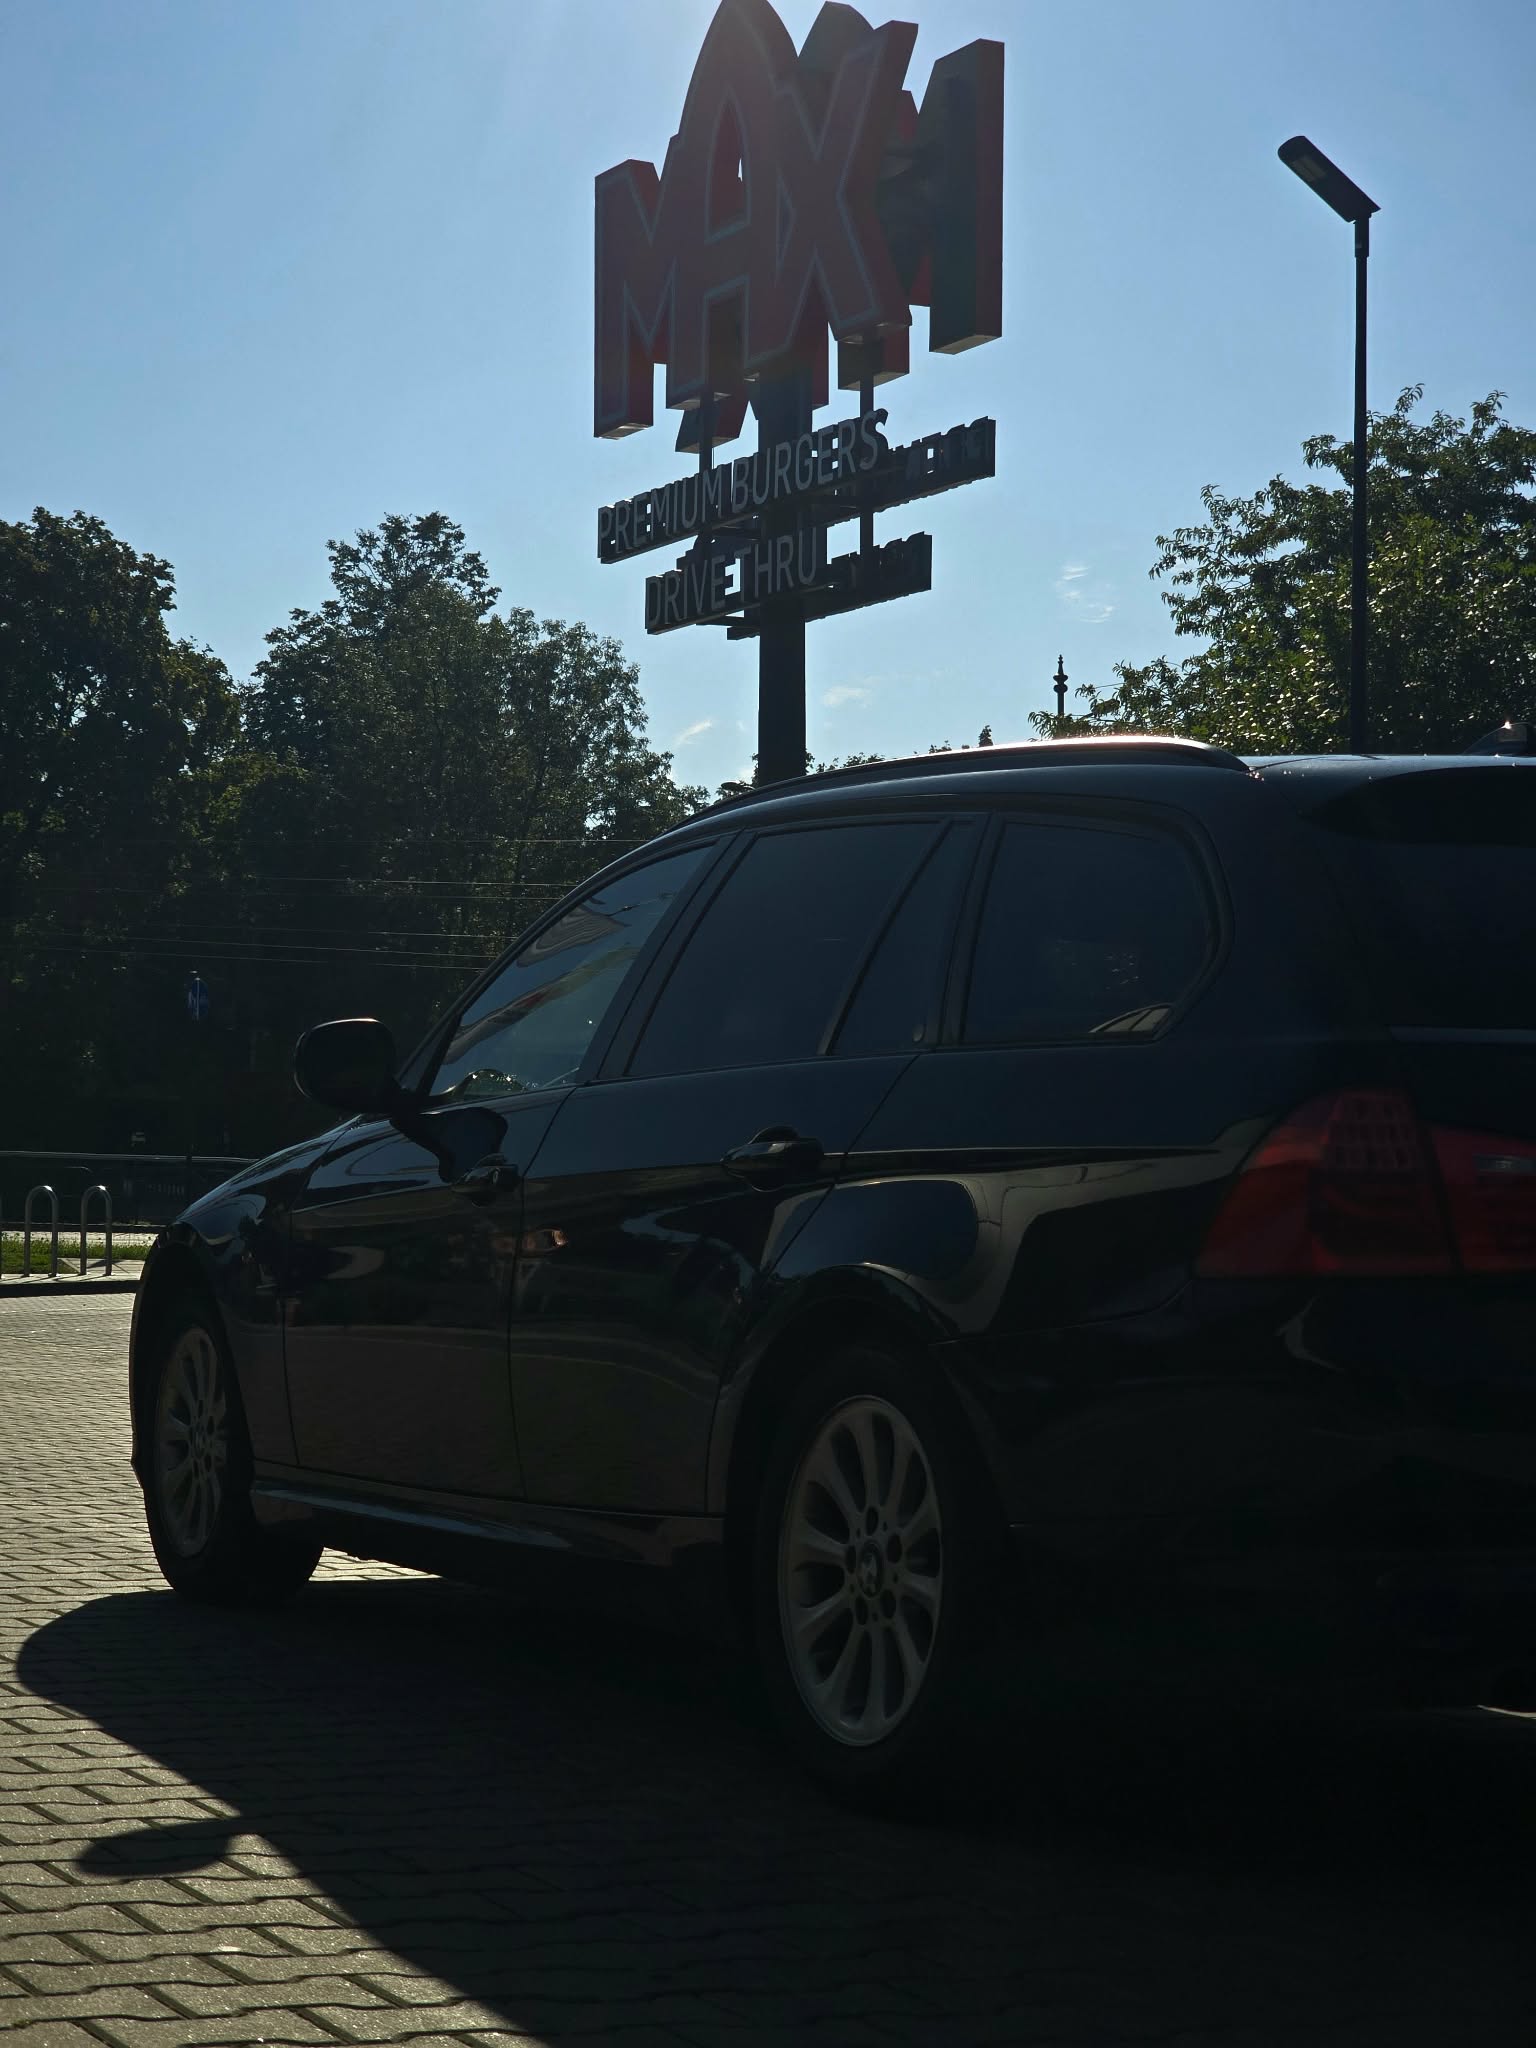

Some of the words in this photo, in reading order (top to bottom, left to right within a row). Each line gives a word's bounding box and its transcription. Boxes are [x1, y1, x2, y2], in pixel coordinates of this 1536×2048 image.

[594, 0, 904, 436] MAX
[598, 465, 724, 553] PREMIUM
[731, 409, 880, 514] BURGERS
[646, 554, 726, 627] DRIVE
[734, 523, 817, 603] THRU
